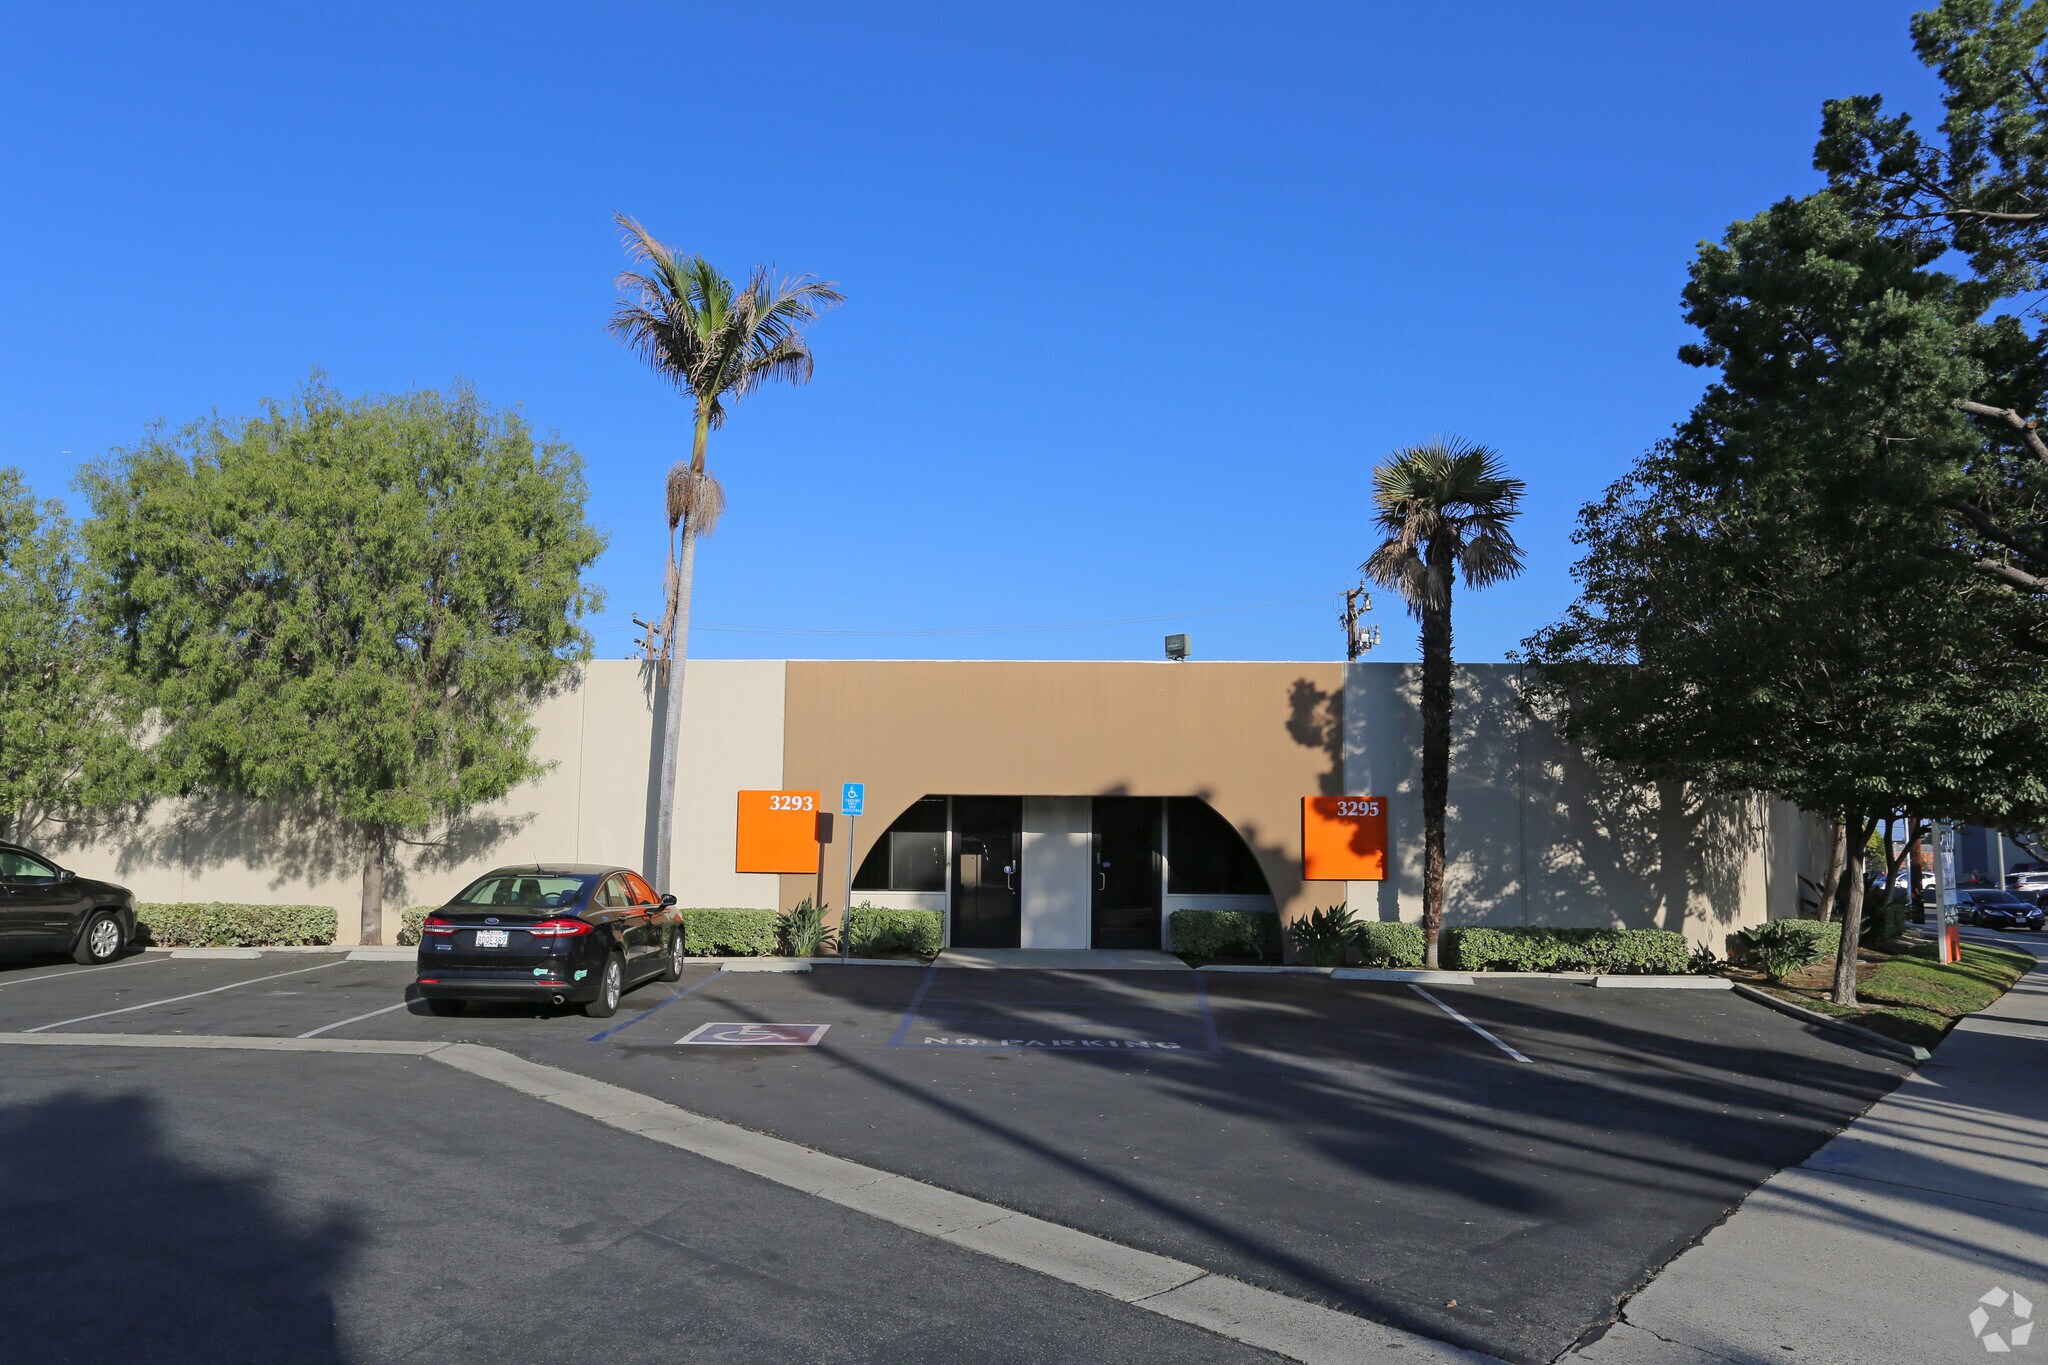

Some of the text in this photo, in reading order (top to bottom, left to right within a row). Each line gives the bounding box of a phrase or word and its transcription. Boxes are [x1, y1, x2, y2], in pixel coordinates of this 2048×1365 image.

[769, 795, 813, 811] 3293
[1337, 801, 1379, 816] 3295
[924, 1037, 1180, 1048] NO PARKING
